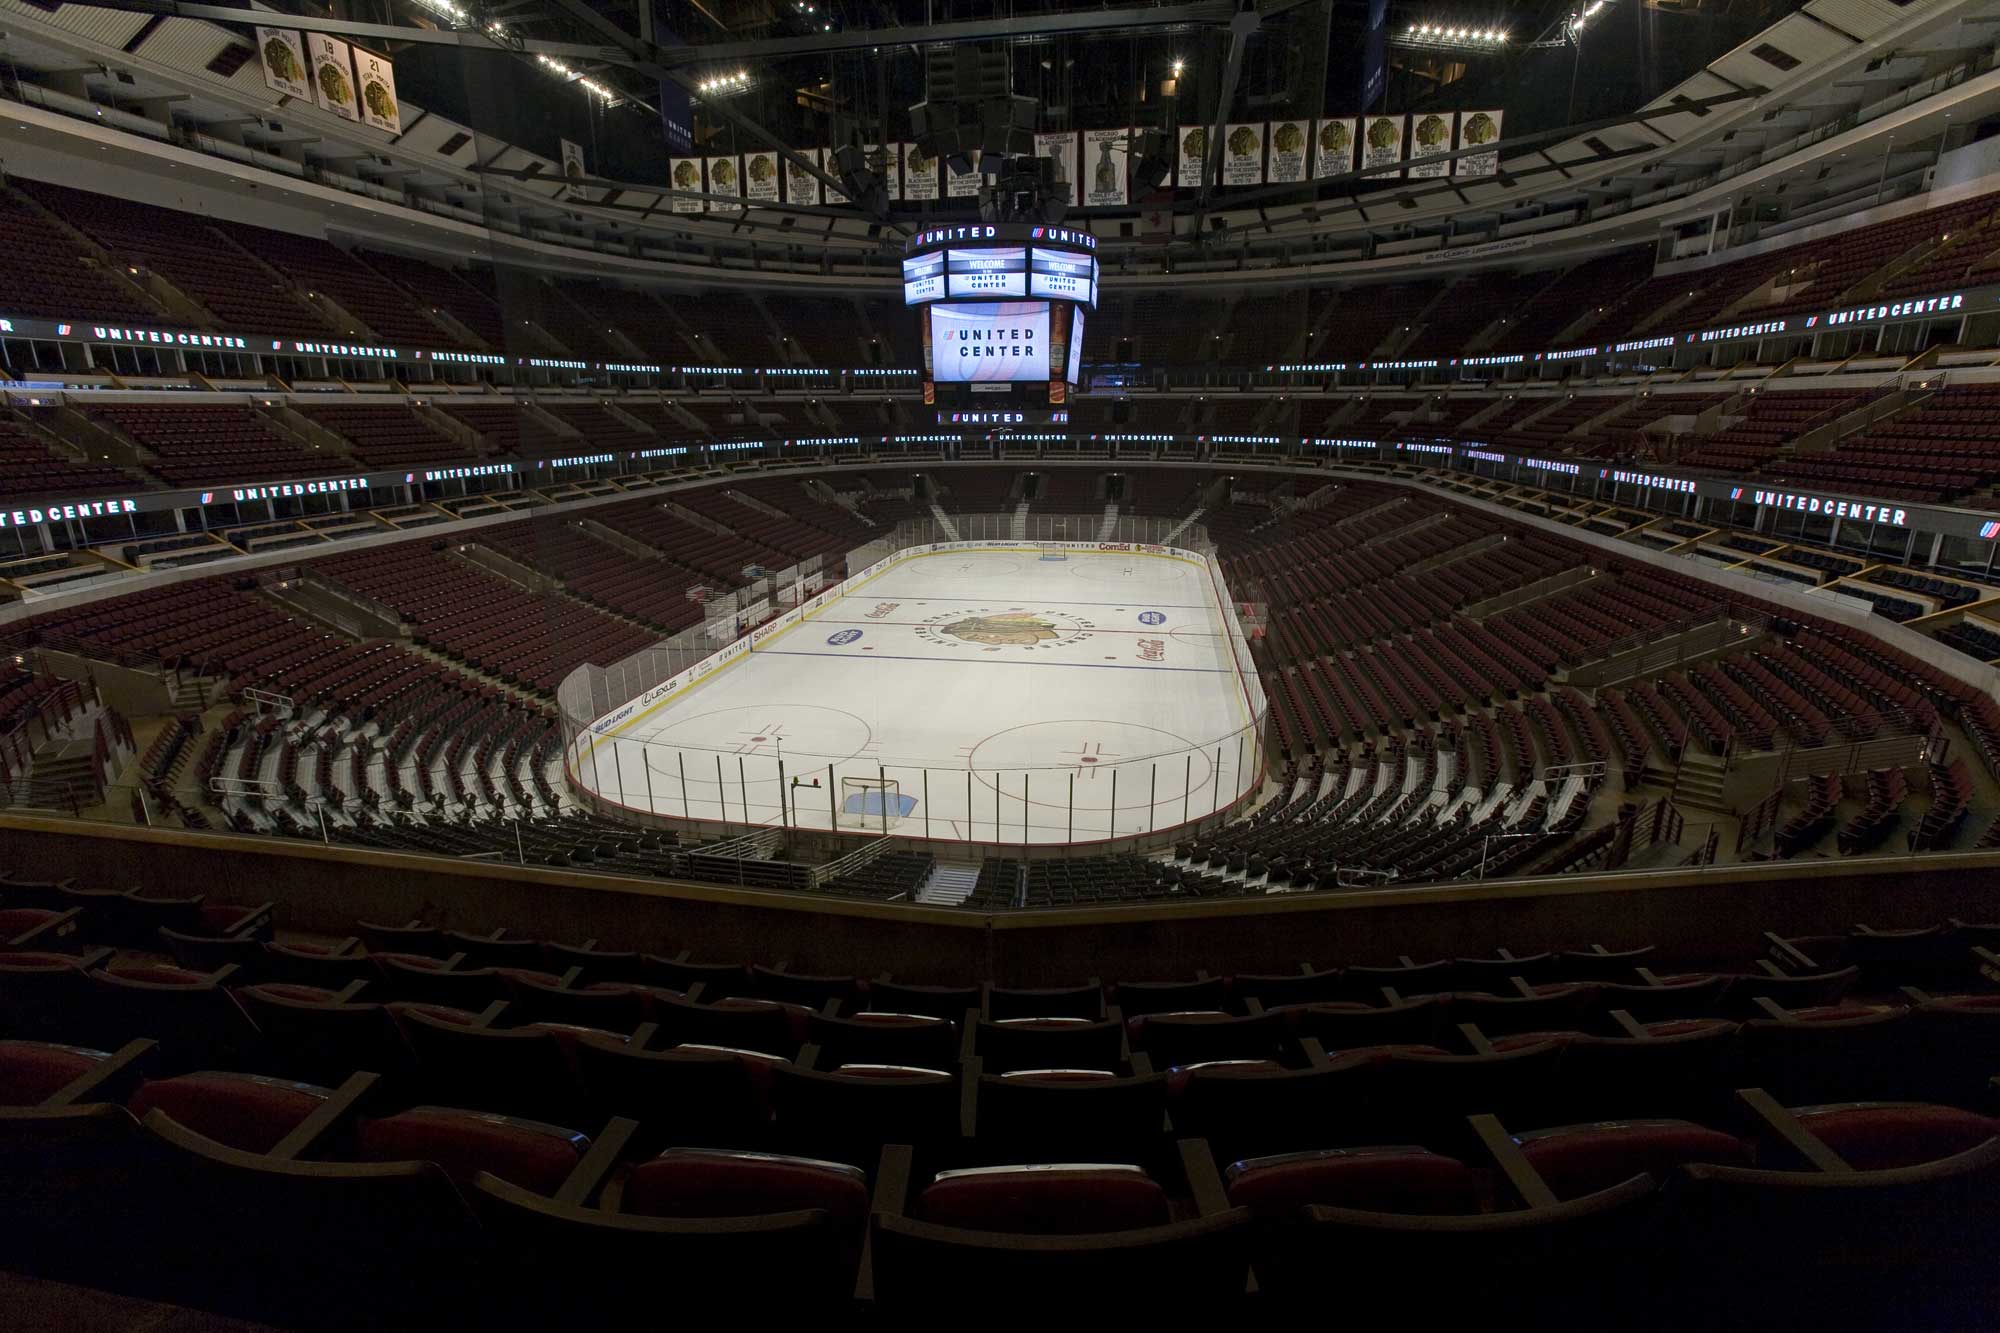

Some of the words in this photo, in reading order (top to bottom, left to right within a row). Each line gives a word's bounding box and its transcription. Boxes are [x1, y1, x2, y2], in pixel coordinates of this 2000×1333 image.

[323, 39, 334, 55] 18
[369, 59, 380, 73] 21
[926, 226, 996, 243] UNITED
[1048, 229, 1096, 249] UNITED
[969, 259, 1005, 270] WELCOME
[971, 281, 1006, 289] CENTER
[1049, 276, 1076, 285] UNITED
[1048, 283, 1076, 292] CENTER
[959, 328, 1034, 341] UNITED
[959, 345, 1034, 357] CENTER
[962, 413, 1024, 423] UNITED
[1098, 542, 1130, 551] ComEd
[753, 622, 777, 642] SHARP
[723, 640, 747, 660] UNITED
[650, 679, 677, 702] LEXUS
[612, 705, 634, 724] LIGHT
